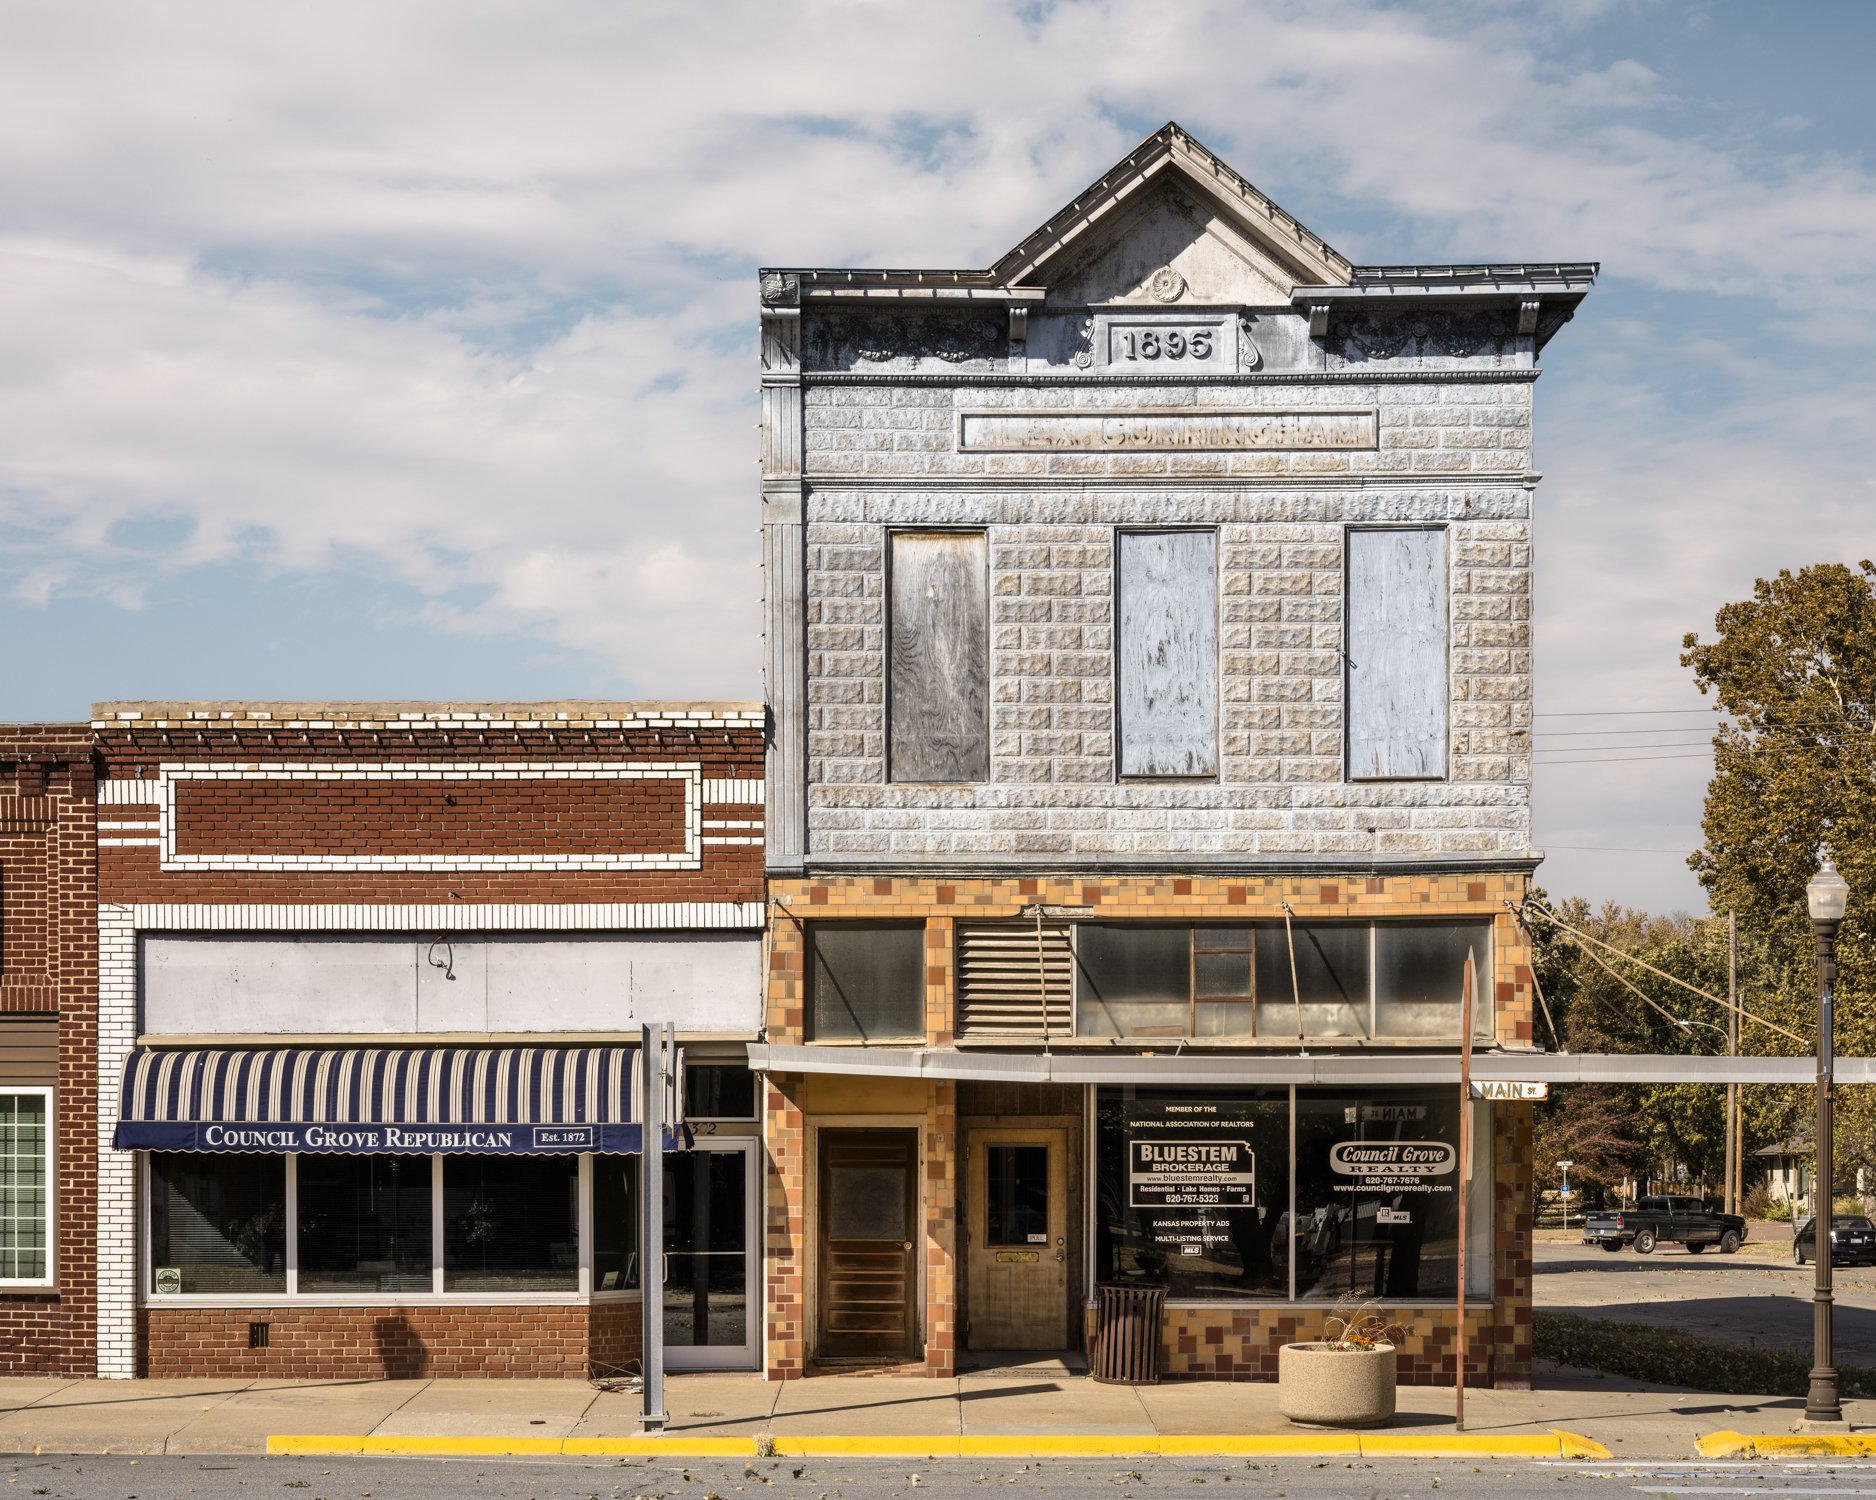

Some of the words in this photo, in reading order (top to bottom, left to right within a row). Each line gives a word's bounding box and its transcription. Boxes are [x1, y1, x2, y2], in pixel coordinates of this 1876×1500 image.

[1123, 330, 1213, 361] 1895
[1481, 1083, 1522, 1098] MAIN
[692, 1122, 717, 1136] 302
[205, 1125, 300, 1146] COUNCIL
[305, 1126, 380, 1148] GROVE
[384, 1127, 513, 1148] REPUBLICAN
[541, 1132, 561, 1142] Est.
[562, 1132, 585, 1142] 1872
[1140, 1144, 1237, 1161] BLUESTEM
[1342, 1146, 1399, 1162] Council
[1402, 1146, 1445, 1162] Grove
[1152, 1163, 1230, 1172] BROKERAGE
[1349, 1165, 1437, 1173] REALTY
[1146, 1174, 1238, 1184] www.bluestemrealty.com
[1365, 1176, 1420, 1184] 620-767-7676
[1140, 1185, 1176, 1193] Residential
[1181, 1185, 1197, 1193] Lake
[1199, 1185, 1221, 1193] Homes
[1226, 1185, 1247, 1193] Farms
[1333, 1184, 1453, 1193] www.councilgroverealty.com
[1165, 1194, 1219, 1203] 620-767-5323
[1183, 1246, 1200, 1254] MLS
